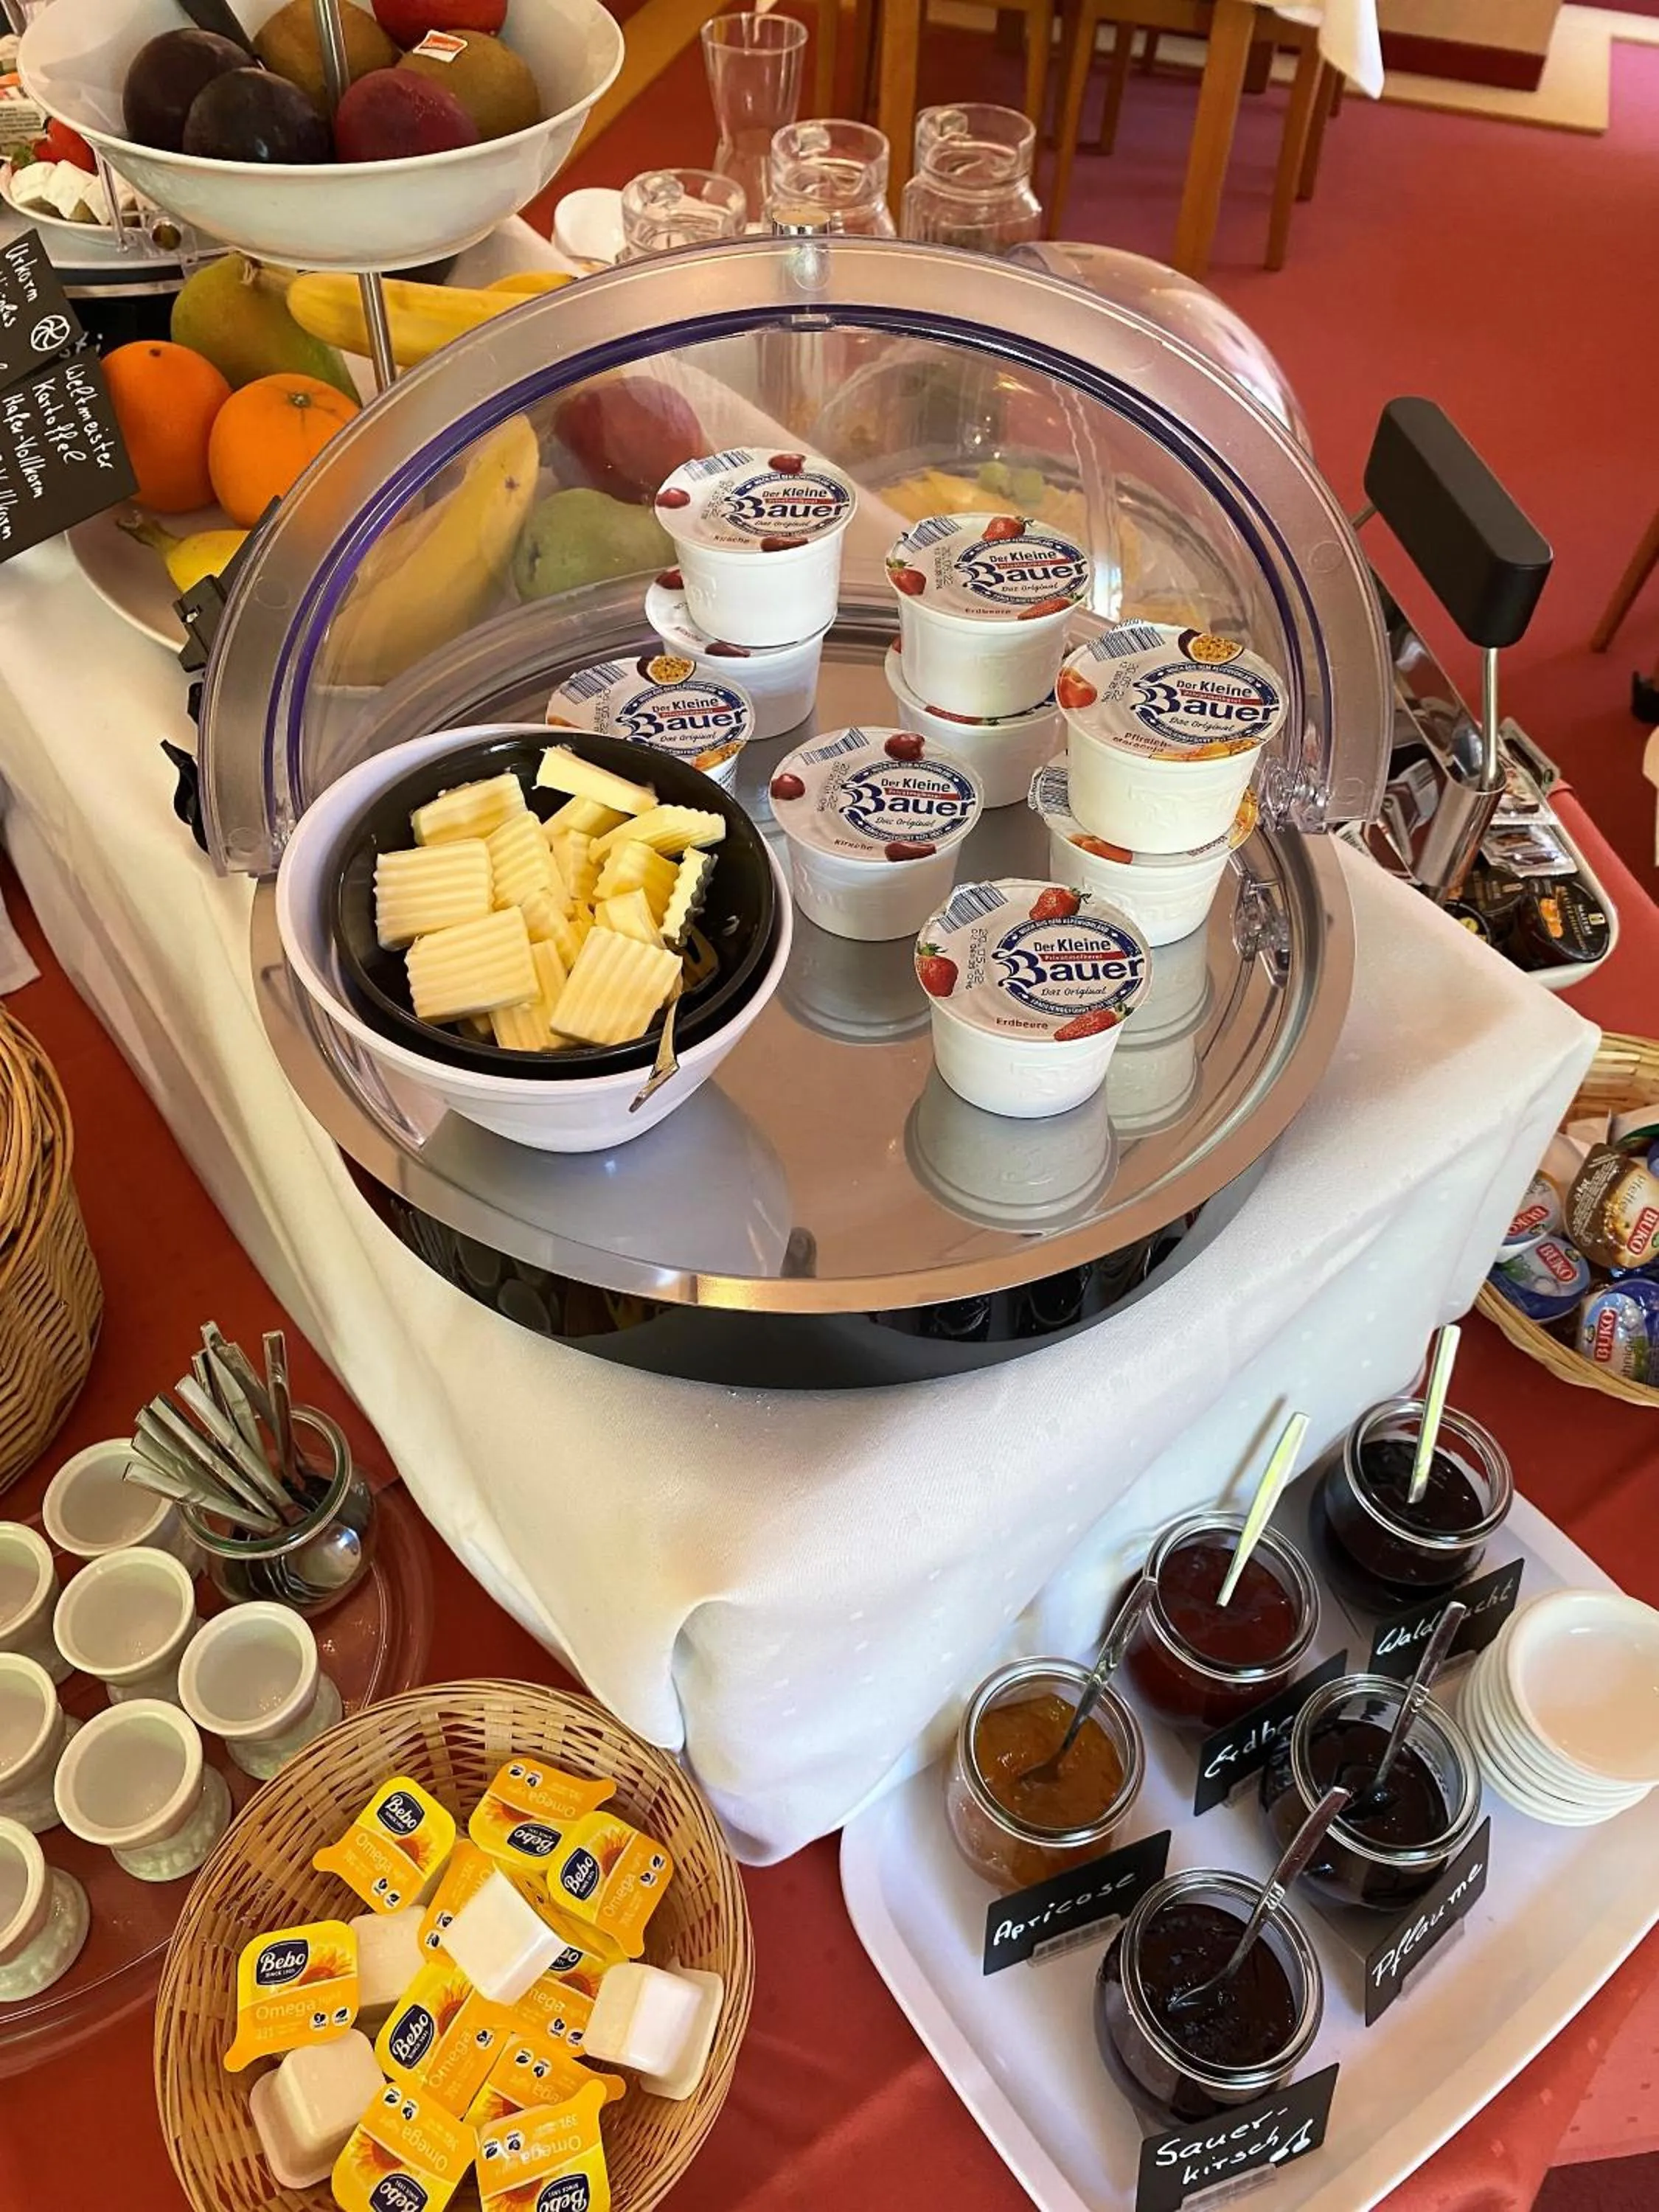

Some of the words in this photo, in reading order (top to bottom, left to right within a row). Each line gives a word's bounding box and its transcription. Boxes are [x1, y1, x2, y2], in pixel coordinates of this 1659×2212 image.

[32, 377, 87, 465] Kartoffel
[65, 363, 115, 470] Weltmeister
[721, 494, 849, 519] Bauer
[783, 487, 827, 498] Kleine
[990, 554, 1008, 563] Der
[1011, 550, 1057, 562] Kleine
[954, 560, 1088, 588] Bauer
[1020, 582, 1060, 594] Original
[652, 705, 671, 713] Der
[672, 698, 719, 710] Kleine
[1130, 682, 1279, 722] Bauer
[1176, 680, 1198, 690] Der
[1200, 681, 1253, 698] Kleine
[616, 708, 748, 738] Bauer
[1191, 720, 1235, 732] Original
[839, 782, 975, 818] Bauer
[880, 778, 901, 787] Der
[902, 778, 951, 793] Kleine
[896, 818, 936, 830] Original
[1034, 942, 1055, 952] Der
[1057, 938, 1111, 952] Kleine
[992, 949, 1144, 989] Bauer
[1064, 986, 1107, 998] Original
[996, 1018, 1048, 1030] Erdbeere
[1631, 1209, 1659, 1254] BUKO
[1538, 1244, 1573, 1281] BUKO
[1596, 1311, 1615, 1359] BUKO
[1375, 1577, 1514, 1655] Walducht
[384, 1795, 418, 1829] Bebo
[528, 1790, 576, 1818] Omega
[355, 1833, 394, 1874] Omega
[514, 1829, 554, 1853] Bebo
[563, 1855, 594, 1894] Bebo
[602, 1874, 636, 1917] Omega
[992, 1871, 1136, 1947] Apricose
[1371, 1863, 1483, 1987] Pflaume
[260, 1950, 306, 1974] Bebo
[256, 1999, 316, 2020] Omega
[392, 2014, 429, 2062] Bebo
[428, 2028, 472, 2089] Omega
[401, 2125, 448, 2172] Omega
[519, 2135, 582, 2165] Omega
[1155, 2107, 1288, 2166] Sauer-
[1181, 2126, 1279, 2185] kirsch
